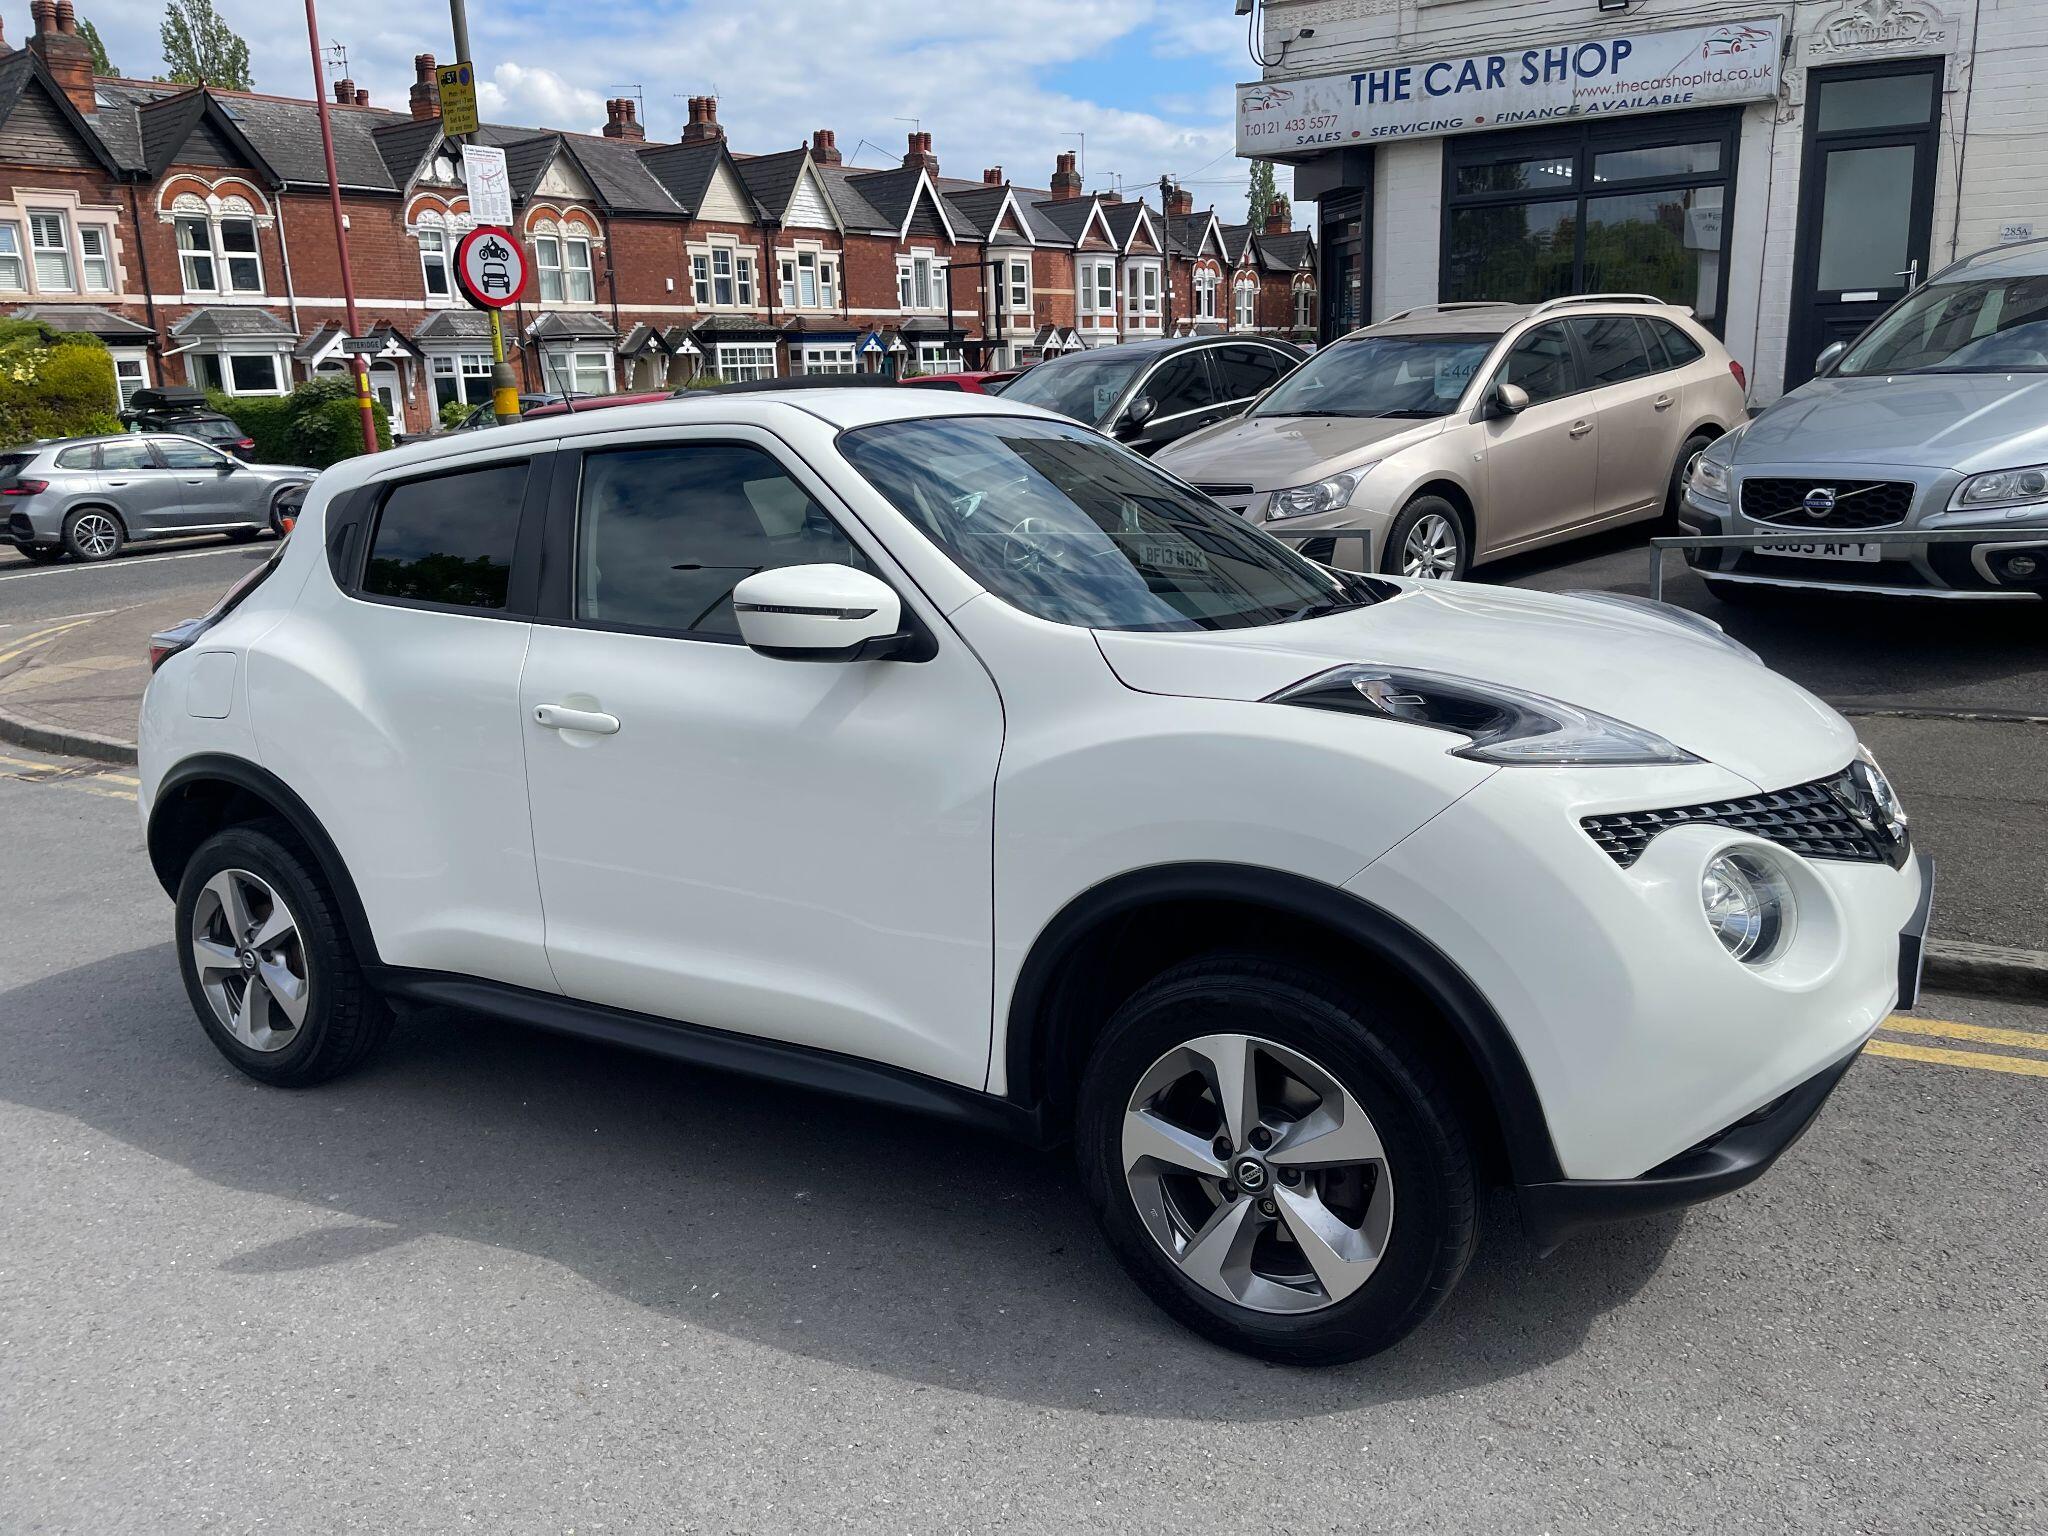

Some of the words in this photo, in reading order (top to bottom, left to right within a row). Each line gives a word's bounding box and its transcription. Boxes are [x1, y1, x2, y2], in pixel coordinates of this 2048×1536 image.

[1350, 67, 1412, 106] THE
[1424, 56, 1506, 97] CAR
[1520, 39, 1633, 86] SHOP
[1573, 64, 1773, 98] www.thecarshopltd.co.uk
[1244, 121, 1280, 137] T:0121
[1284, 118, 1306, 133] 433
[1308, 114, 1339, 130] 5577
[1295, 131, 1342, 146] SALES
[1369, 117, 1464, 138] SERVICING
[1495, 104, 1581, 124] FINANCE
[1584, 91, 1694, 114] AVAILABLE
[2004, 226, 2028, 236] 285A
